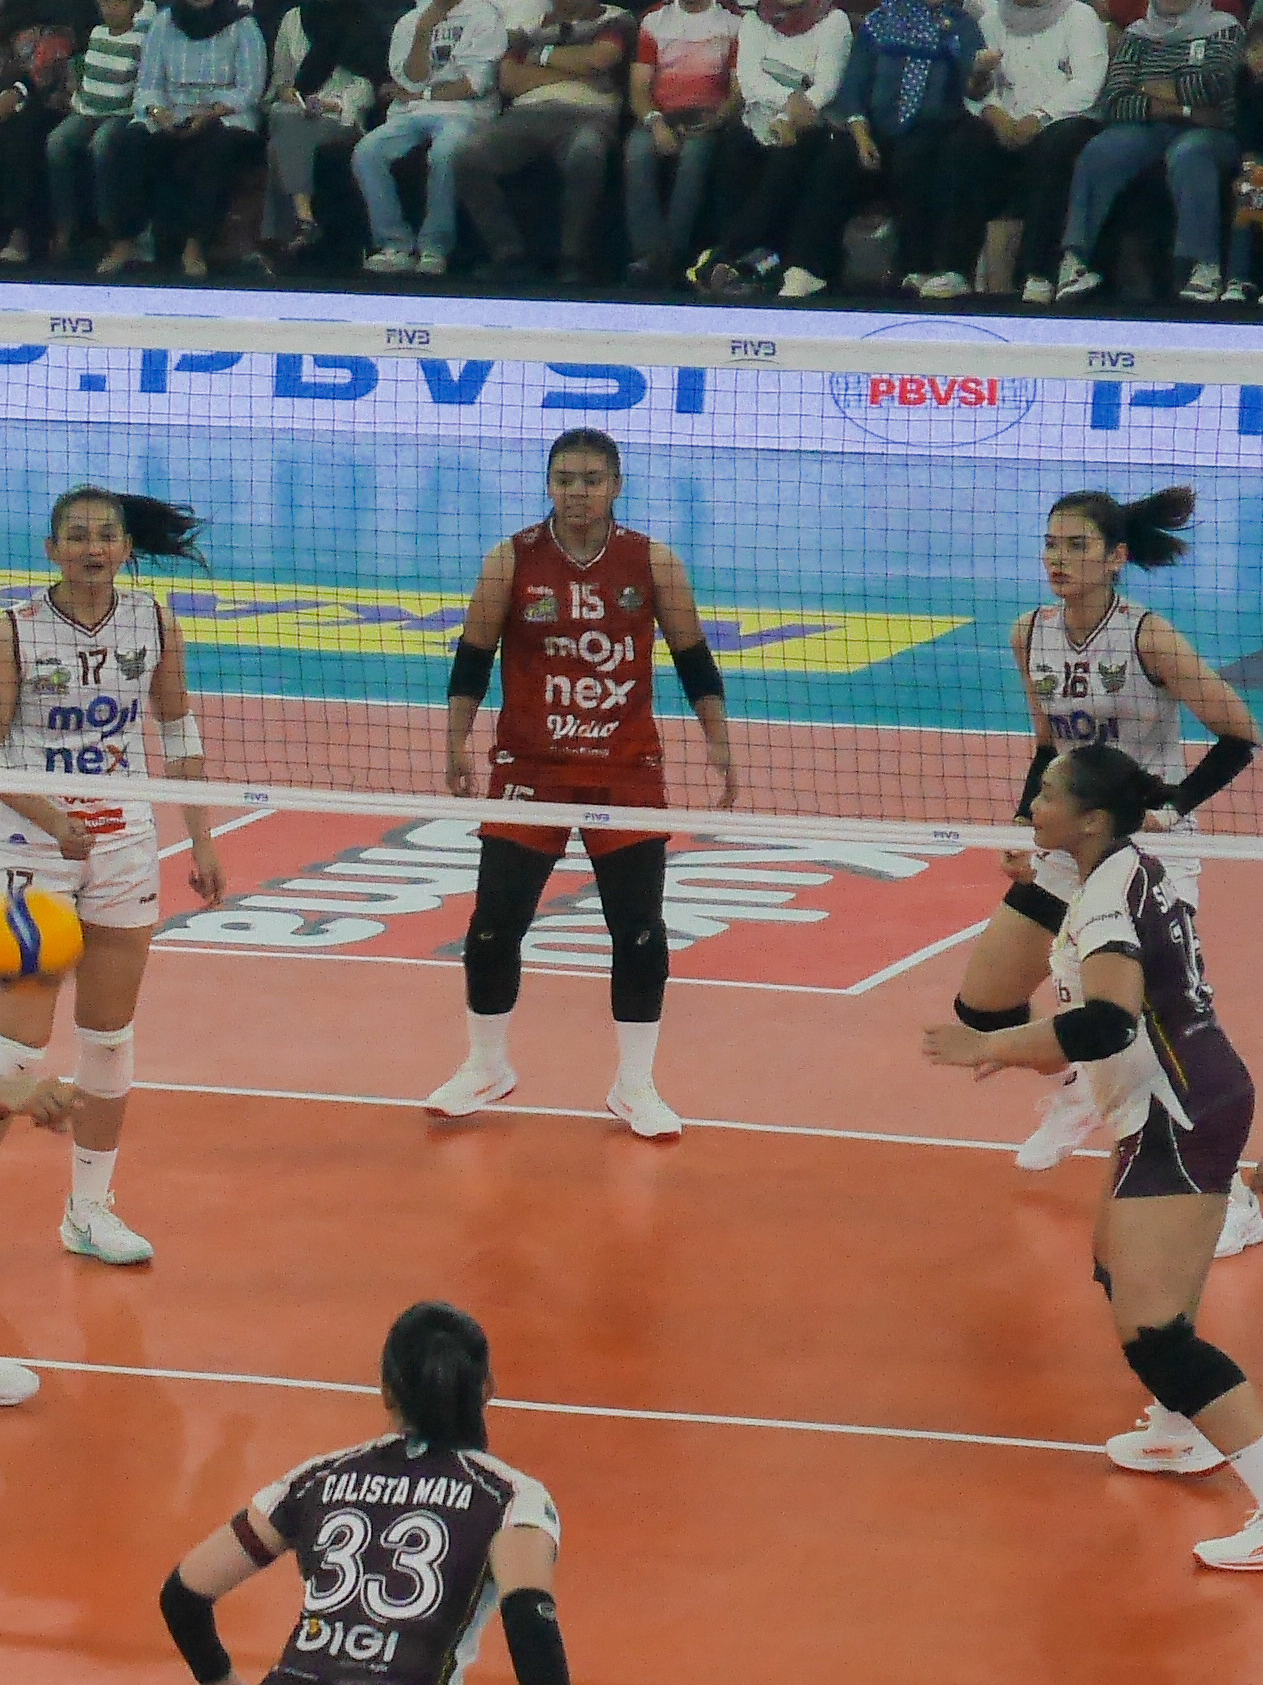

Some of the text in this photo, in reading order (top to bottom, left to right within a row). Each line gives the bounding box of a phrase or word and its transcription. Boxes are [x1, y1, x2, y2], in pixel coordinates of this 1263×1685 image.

[50, 316, 93, 333] FIVB
[386, 328, 430, 345] FIVB
[731, 340, 777, 357] FIVB
[1088, 351, 1136, 368] FIVB
[867, 375, 1000, 408] PBVSI
[568, 581, 606, 620] 15
[77, 647, 108, 686] 17
[1063, 660, 1089, 698] 16
[544, 673, 637, 710] nex
[546, 713, 620, 740] Vidio
[44, 742, 131, 774] nex
[322, 1472, 474, 1510] CALISTA MAYA
[304, 1506, 451, 1624] 33
[295, 1618, 400, 1663] DIGI
